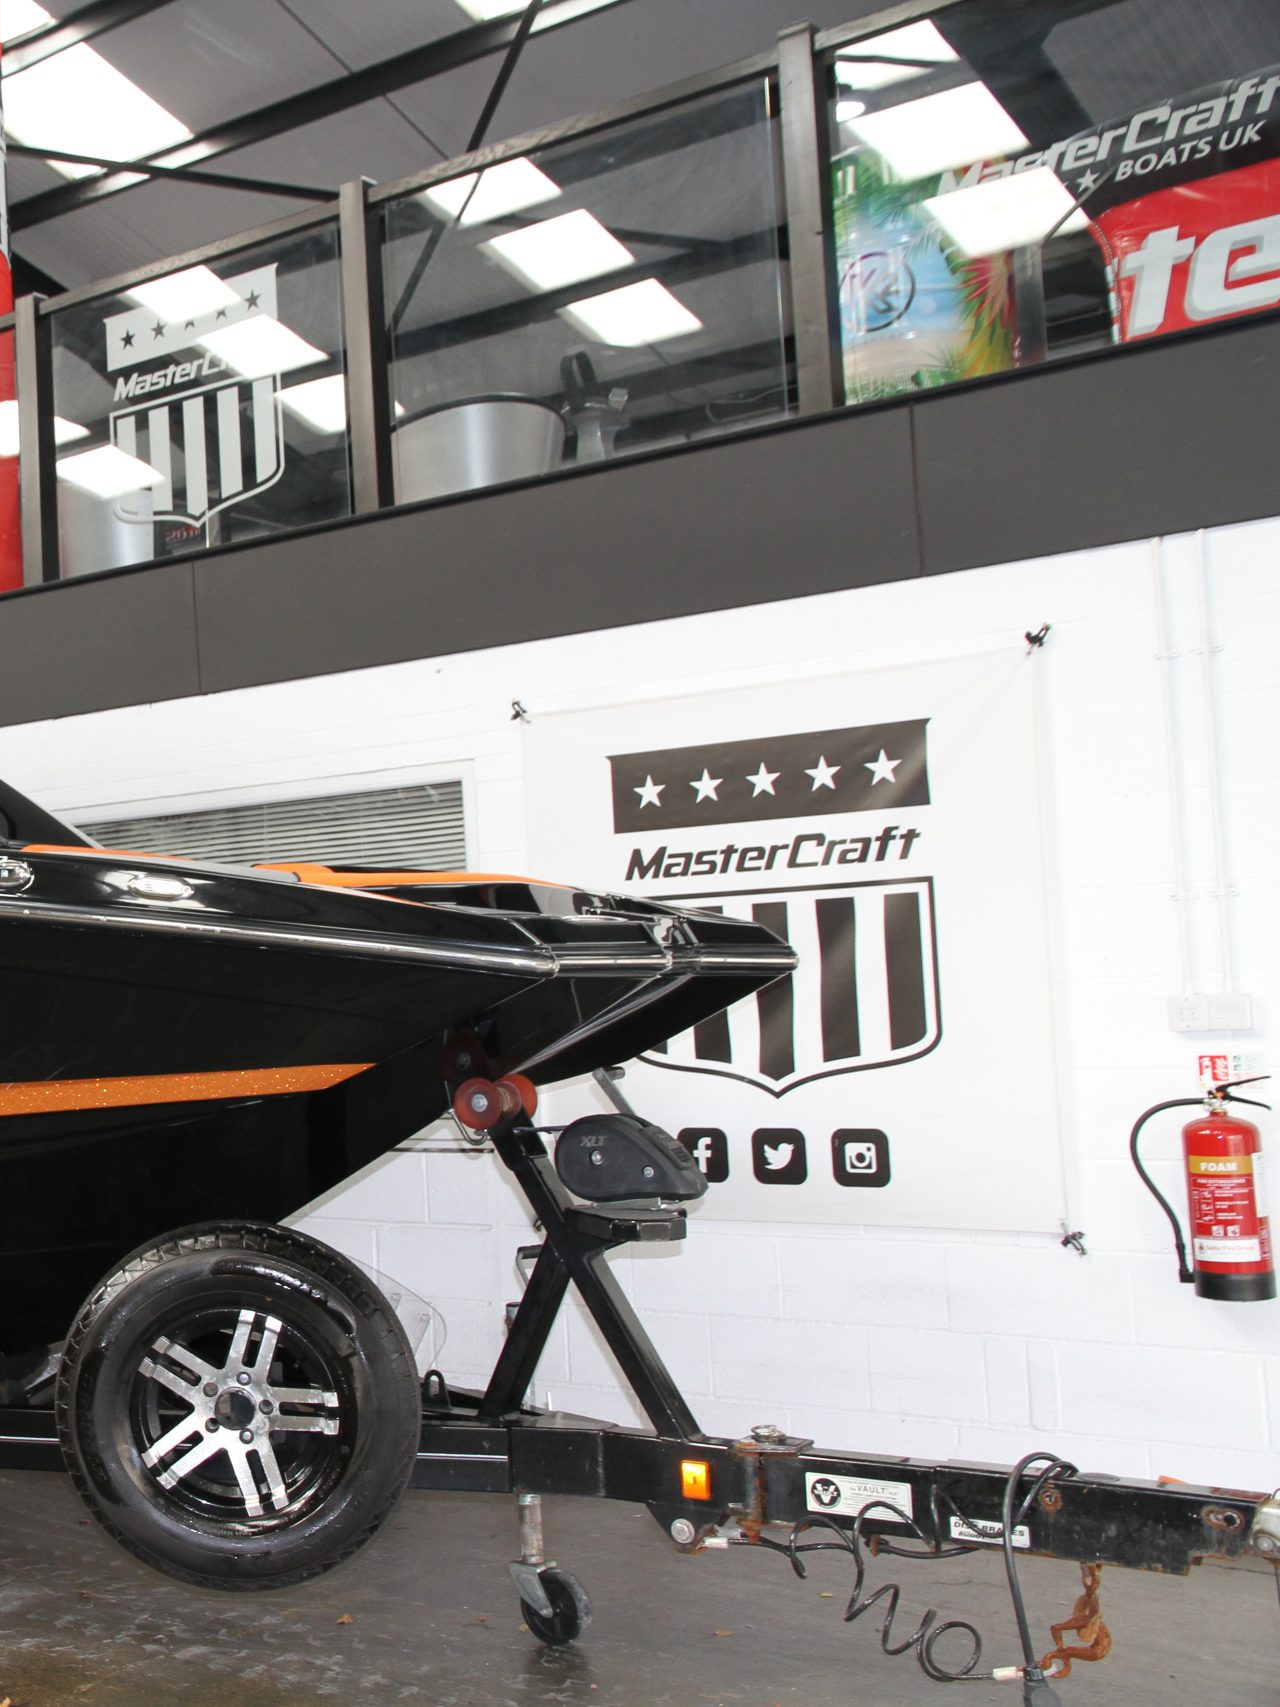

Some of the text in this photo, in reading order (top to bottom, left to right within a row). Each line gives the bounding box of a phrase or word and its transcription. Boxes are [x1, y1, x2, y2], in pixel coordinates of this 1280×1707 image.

[1113, 119, 1267, 183] BOATS UK
[624, 826, 921, 881] MasterCraft
[1199, 1162, 1238, 1172] FOAM
[856, 1484, 886, 1495] VAULT
